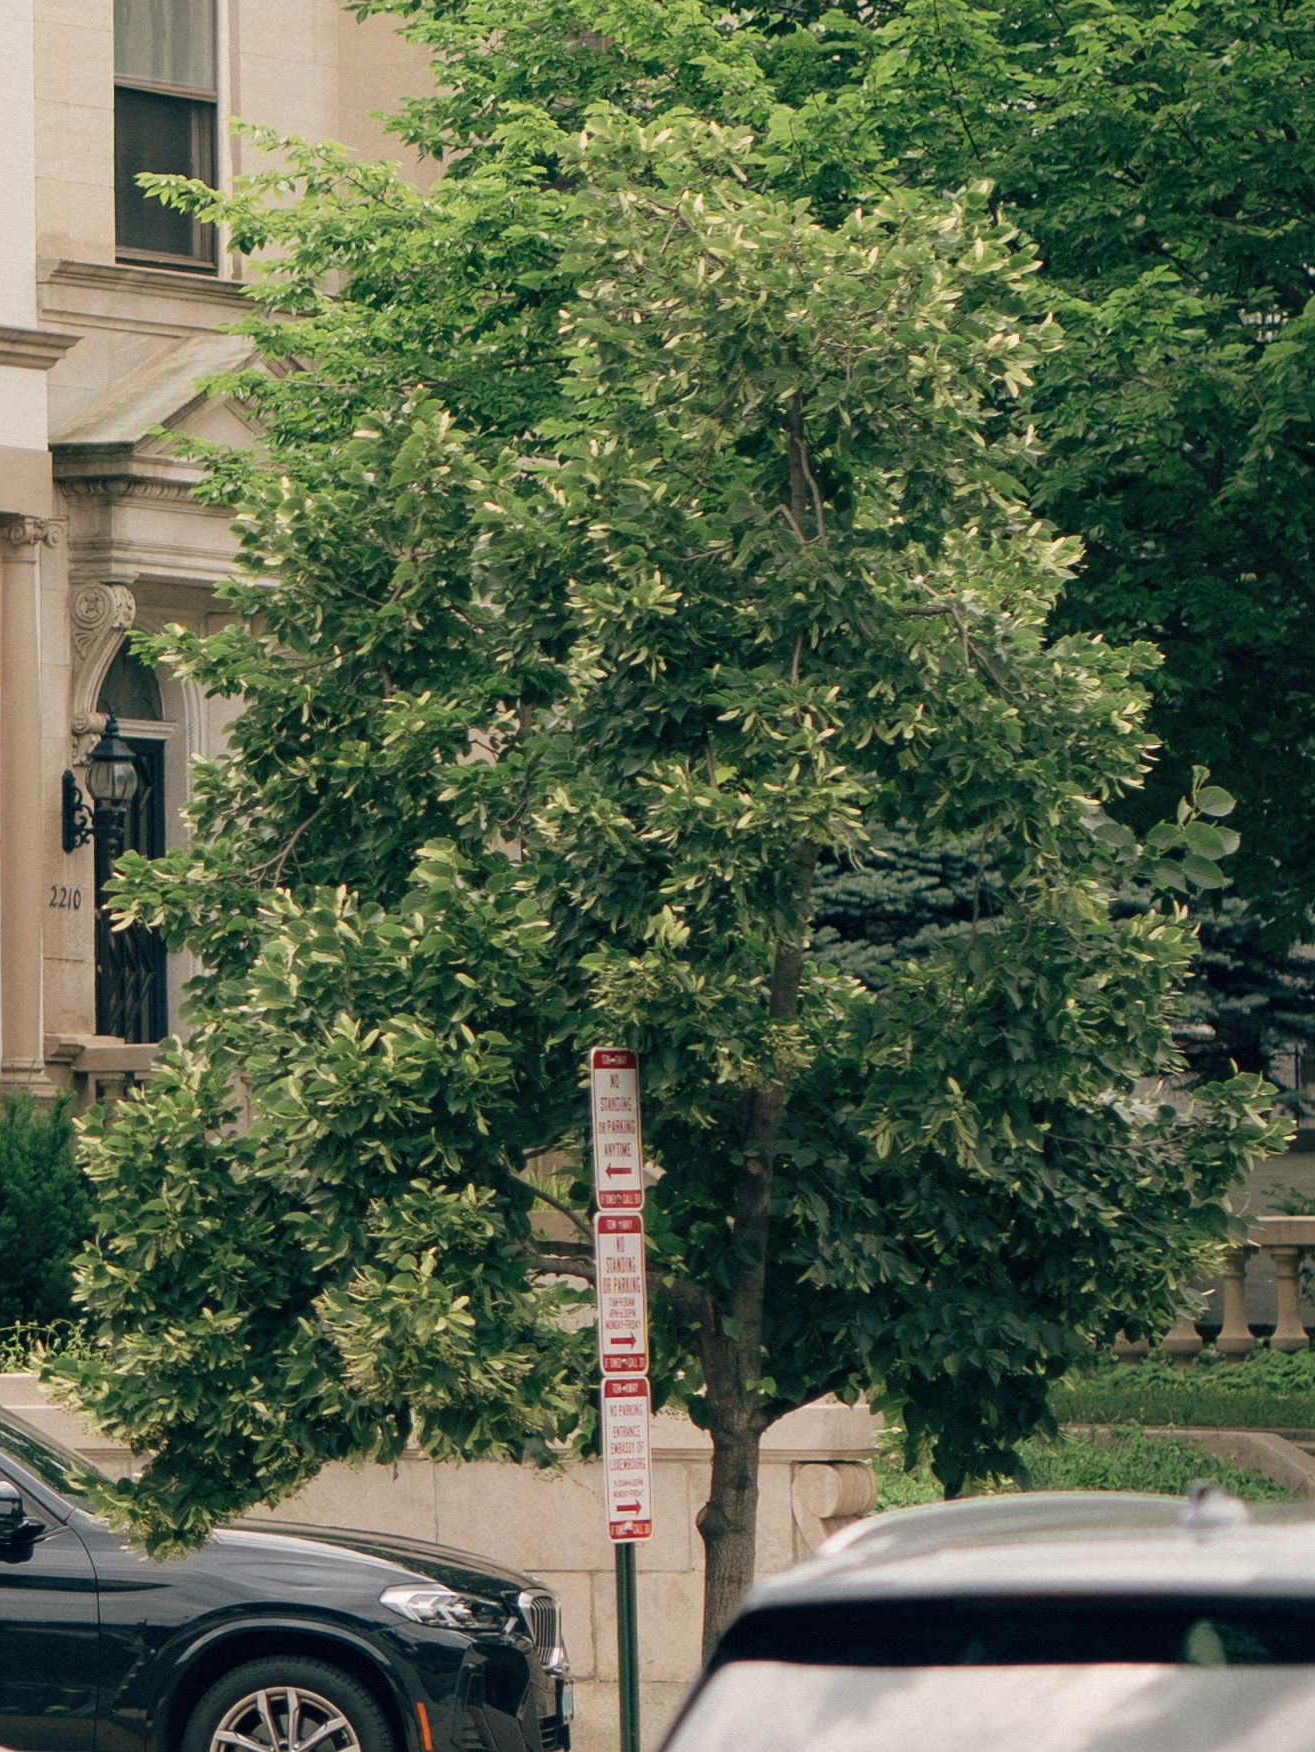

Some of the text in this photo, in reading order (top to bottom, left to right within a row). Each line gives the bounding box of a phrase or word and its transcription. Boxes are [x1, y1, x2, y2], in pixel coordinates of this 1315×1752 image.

[49, 886, 82, 910] 2210
[610, 1073, 619, 1089] NO
[600, 1097, 632, 1112] STANDING
[607, 1120, 635, 1134] PARKING
[604, 1143, 632, 1157] ANYTIME
[615, 1237, 625, 1253] NO
[606, 1257, 636, 1273] STANDING
[603, 1277, 640, 1294] OR PARKING
[610, 1404, 643, 1417] NO PARKING
